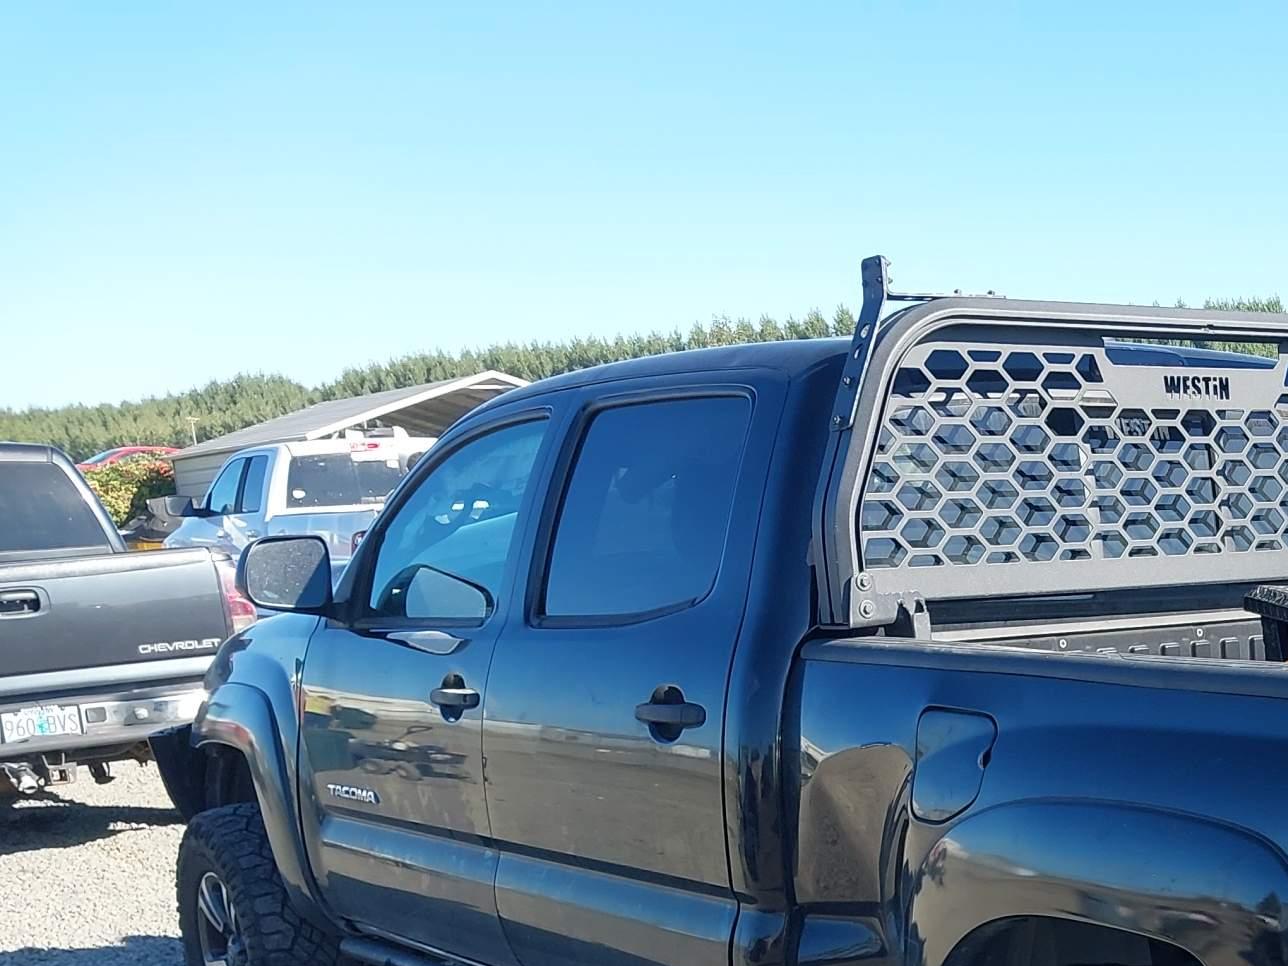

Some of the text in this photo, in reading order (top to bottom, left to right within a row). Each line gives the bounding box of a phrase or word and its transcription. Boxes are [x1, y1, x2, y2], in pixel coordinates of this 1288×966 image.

[138, 637, 222, 654] CHEVROLET
[4, 713, 79, 738] 960 BVS
[327, 784, 377, 804] TACOMA
